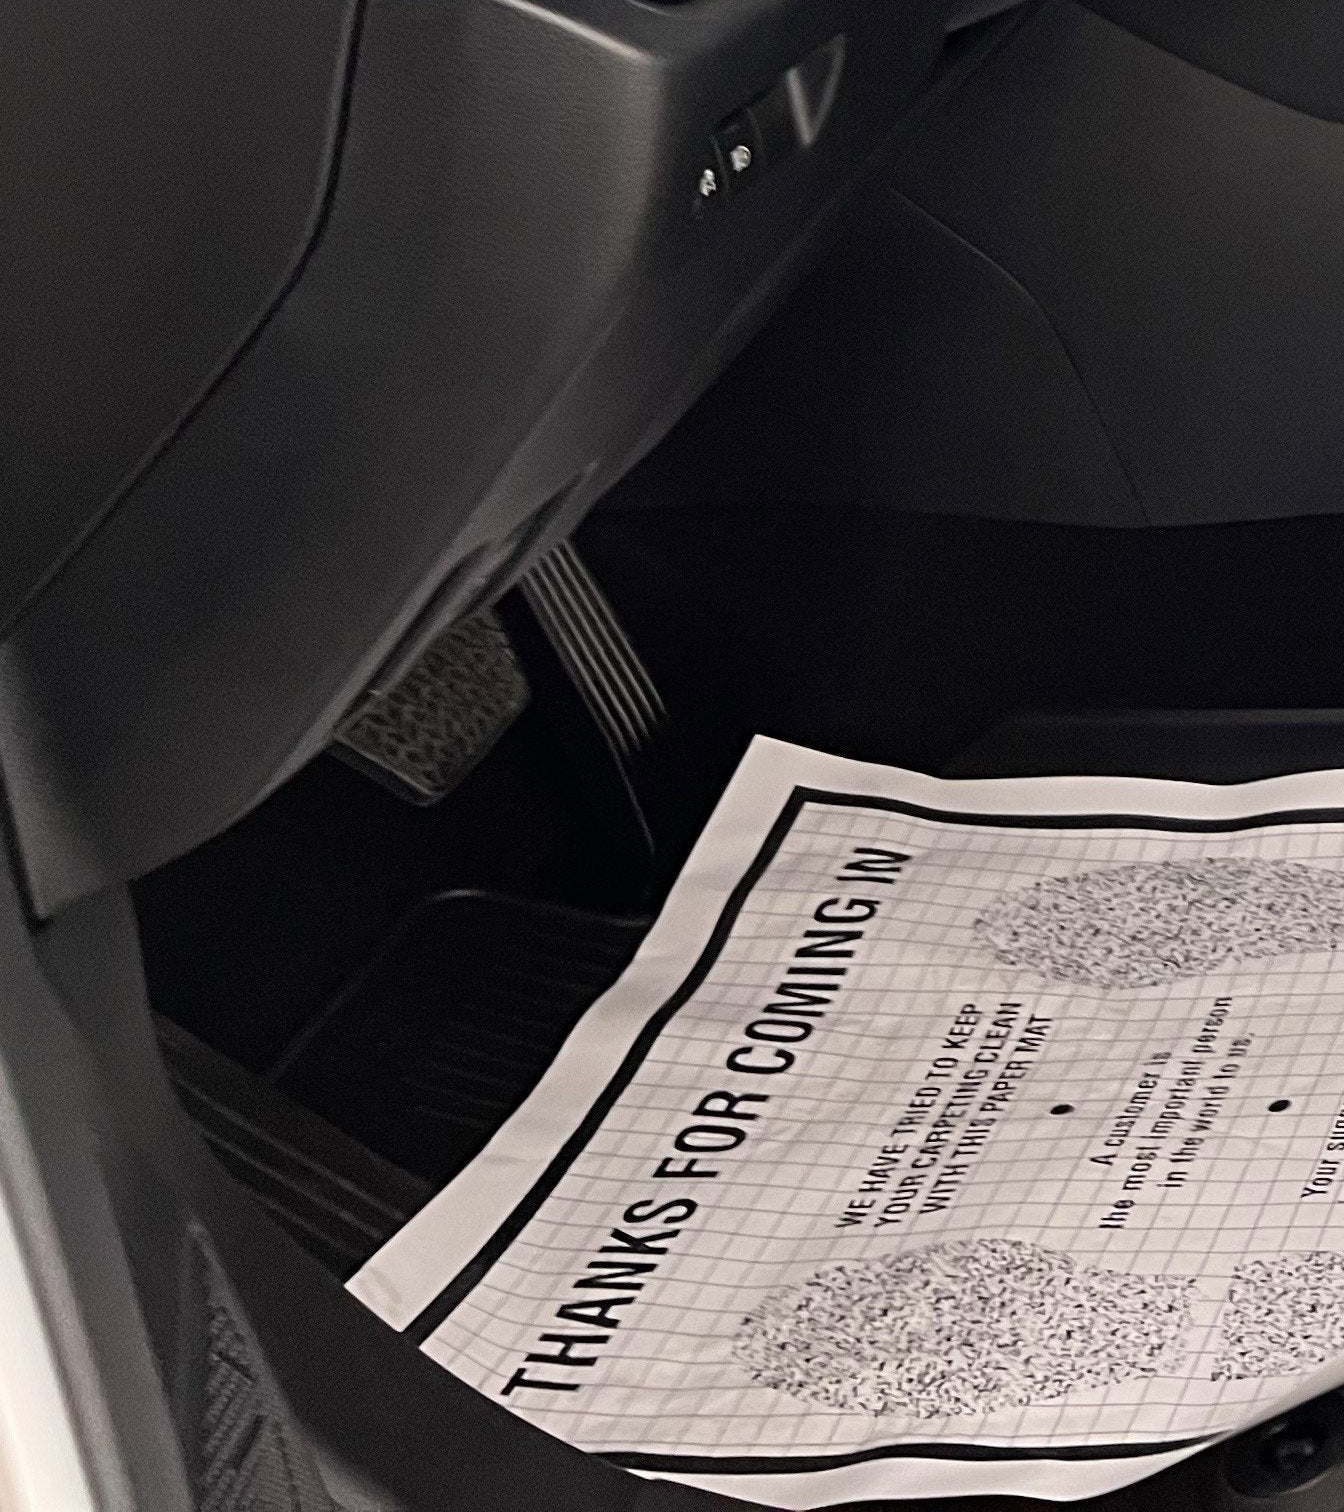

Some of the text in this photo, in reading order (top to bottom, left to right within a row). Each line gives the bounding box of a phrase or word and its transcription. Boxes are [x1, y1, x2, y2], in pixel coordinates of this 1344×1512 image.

[501, 846, 913, 1397] THANKS FOR COMING IN
[833, 1003, 984, 1229] WE HAVE TRIED TO KEEP
[873, 1002, 1024, 1228] YOUR CARPETING CLEAN
[918, 1013, 1054, 1215] WITH THIS PAPER MAT
[1090, 1051, 1173, 1167] A customer is
[1098, 996, 1233, 1230] the most important person
[1190, 1085, 1231, 1132] world
[1211, 1063, 1241, 1079] to
[1156, 1170, 1190, 1188] in
[1168, 1137, 1205, 1163] the
[1300, 1158, 1341, 1199] Your
